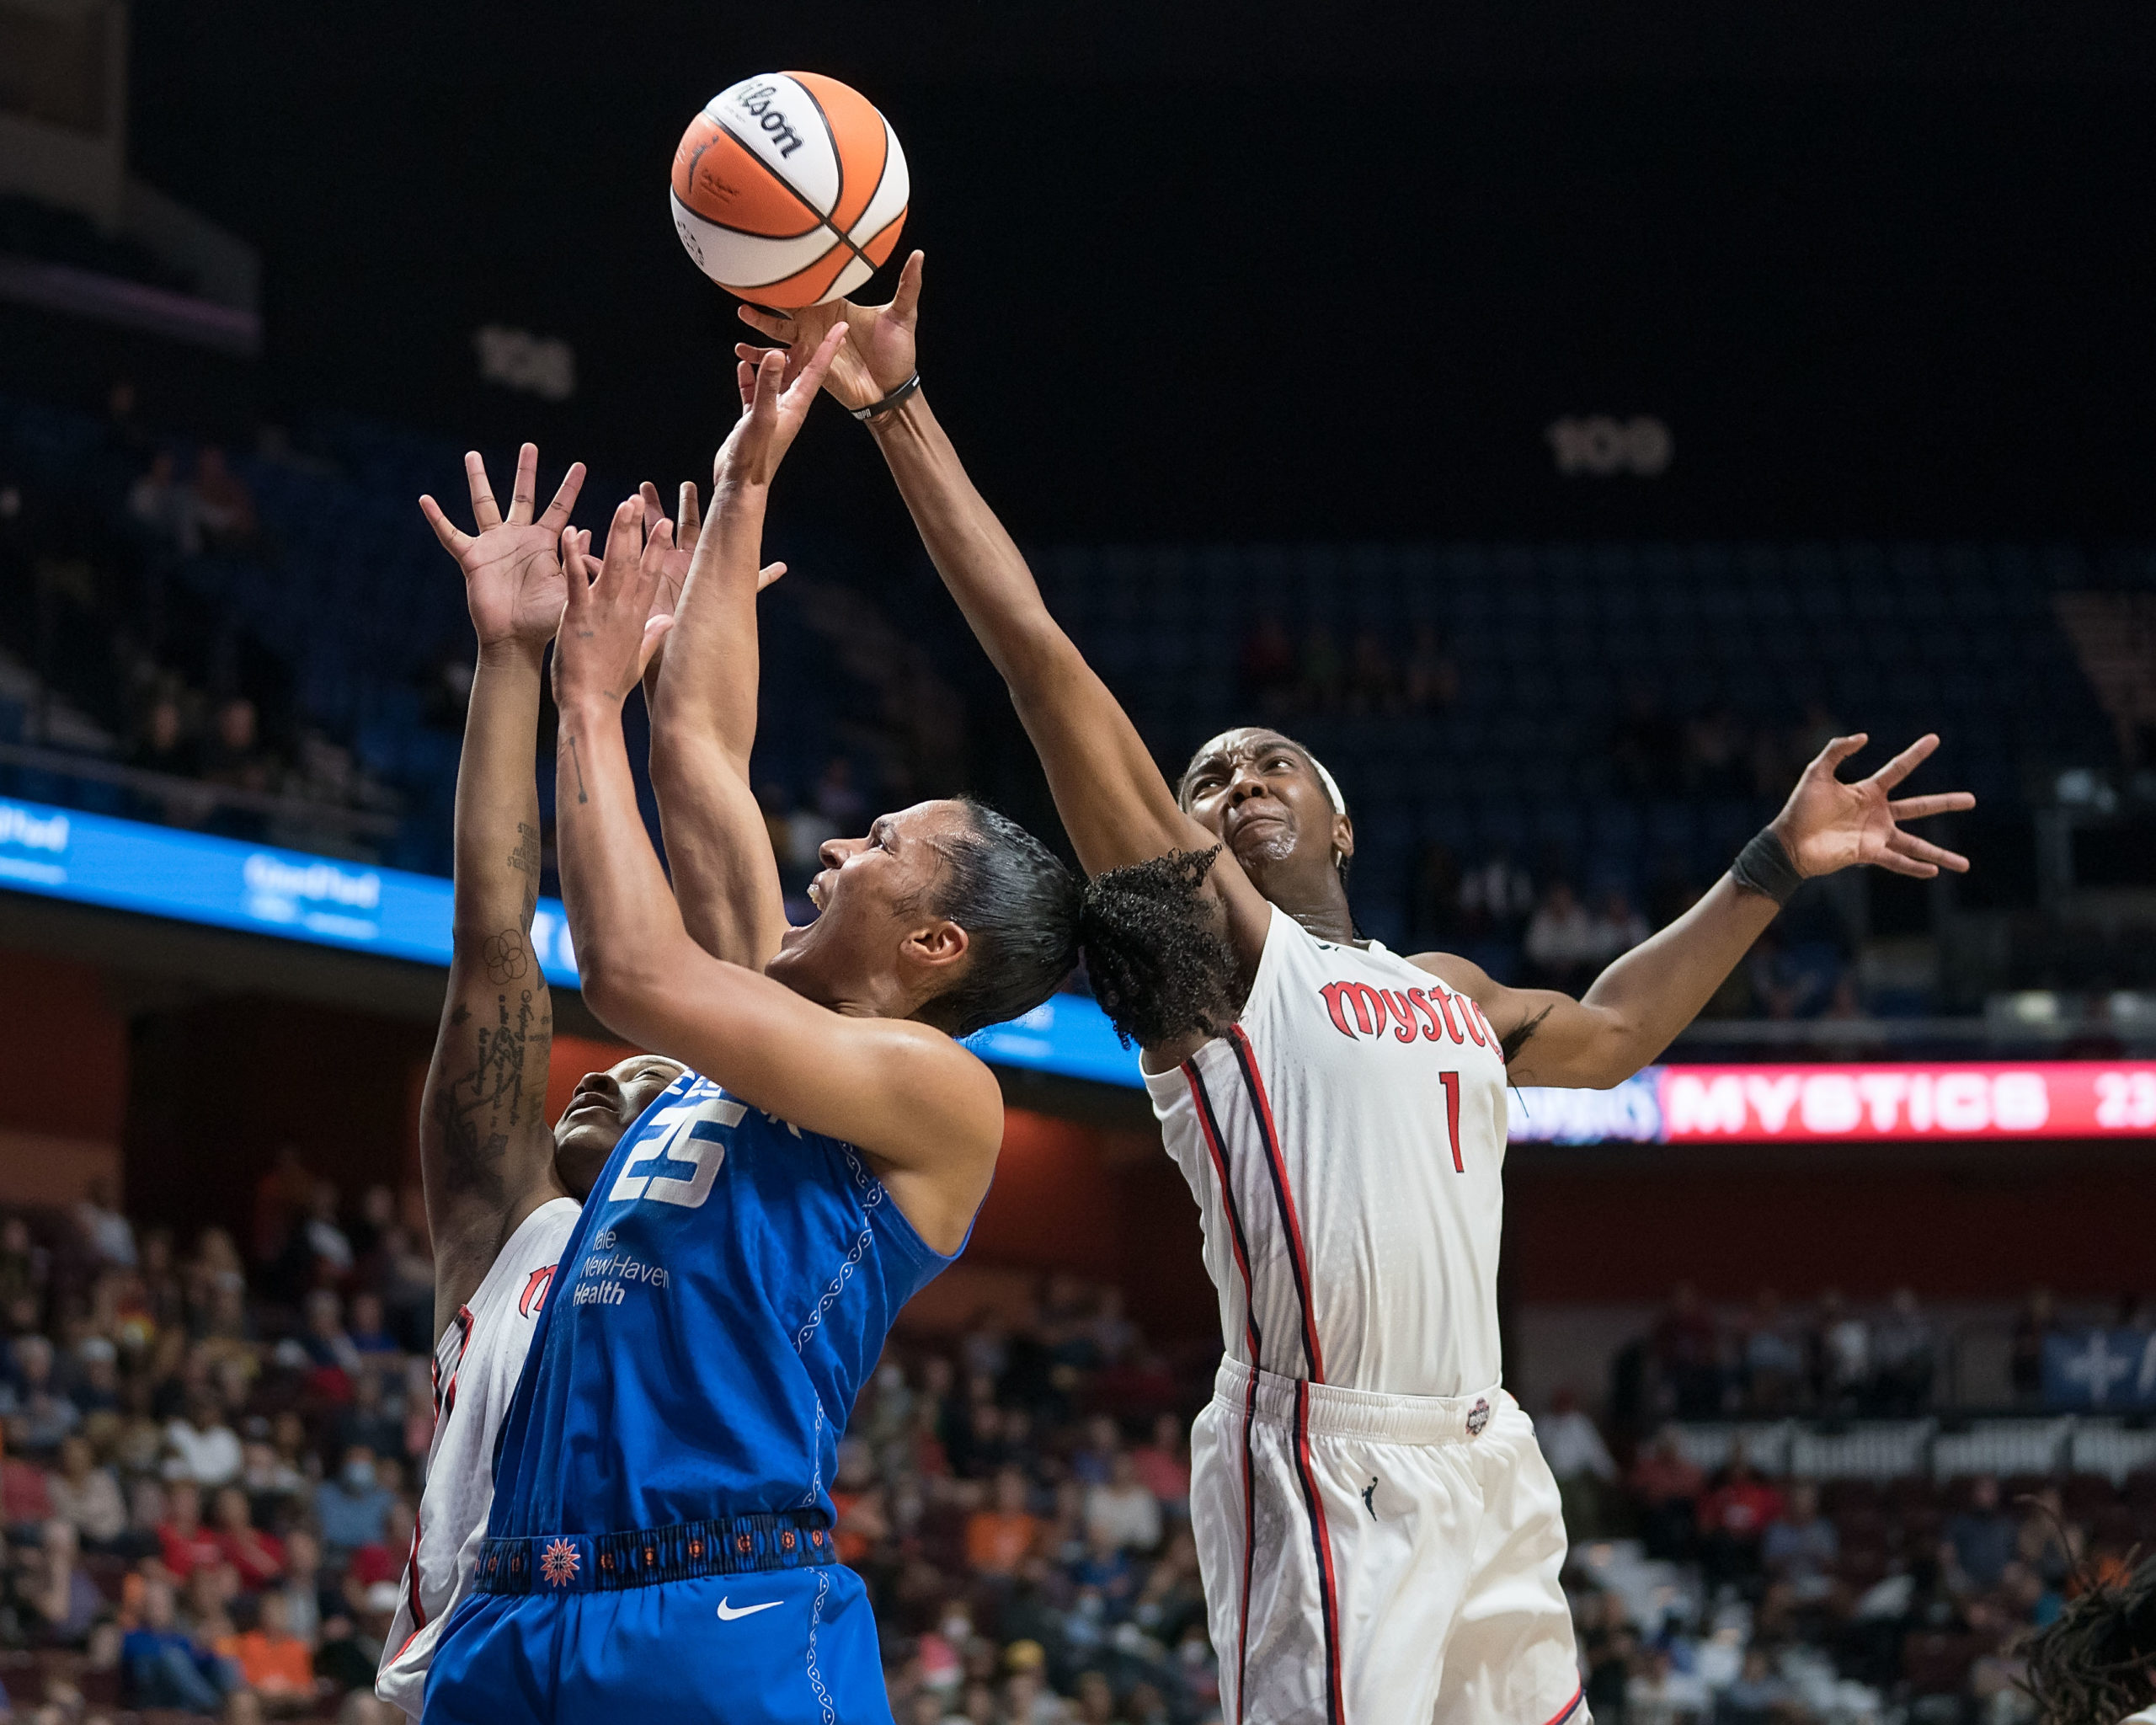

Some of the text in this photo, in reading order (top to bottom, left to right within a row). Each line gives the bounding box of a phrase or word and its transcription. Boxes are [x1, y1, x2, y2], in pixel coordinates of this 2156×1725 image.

[735, 82, 803, 159] ilson
[1319, 981, 1504, 1065] Mystic
[1438, 1071, 1464, 1172] 1
[1668, 1072, 2049, 1135] MYSTICS
[608, 1097, 748, 1209] 25
[573, 1279, 626, 1307] Health
